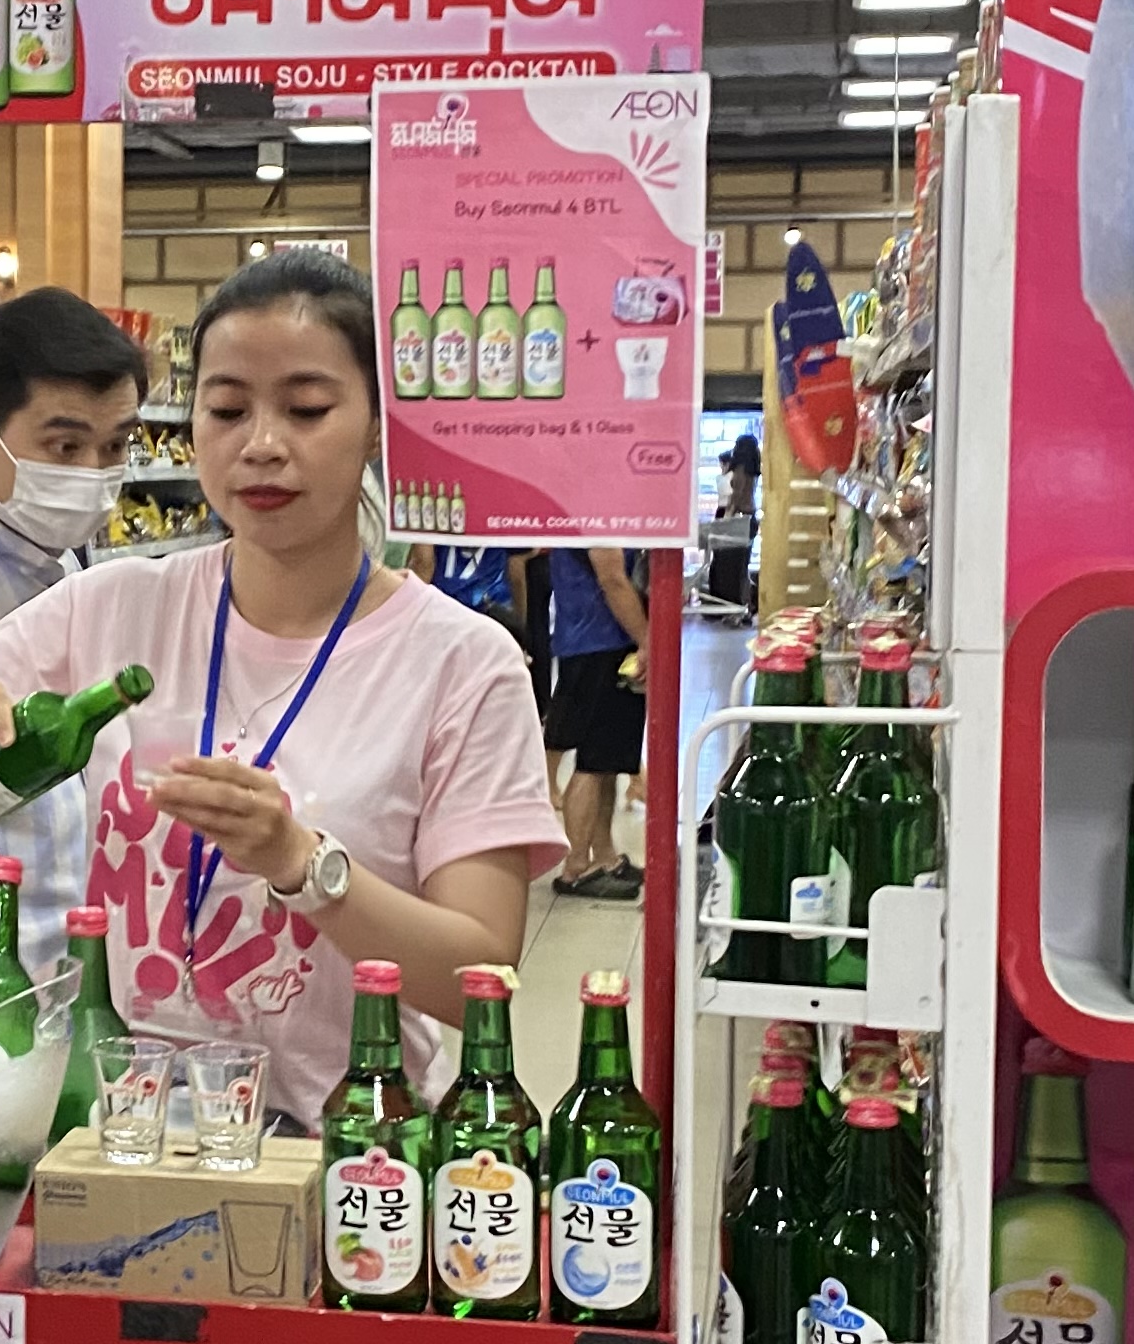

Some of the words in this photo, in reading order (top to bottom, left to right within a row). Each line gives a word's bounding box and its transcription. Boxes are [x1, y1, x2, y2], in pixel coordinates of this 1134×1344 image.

[16, 3, 66, 31] 선물
[276, 65, 347, 88] SOJU
[373, 61, 458, 82] STYLE
[455, 170, 522, 188] SPECIAL
[527, 167, 625, 187] PROMOTION
[455, 200, 486, 221] Buy
[491, 198, 561, 217] Seonmul
[567, 199, 577, 214] 4
[584, 198, 621, 215] BTL
[471, 421, 535, 437] shopping
[539, 422, 566, 437] bag
[637, 448, 675, 466] Free
[338, 1186, 411, 1232] 선물
[447, 1190, 521, 1236] 선물
[561, 1203, 641, 1247] 선물
